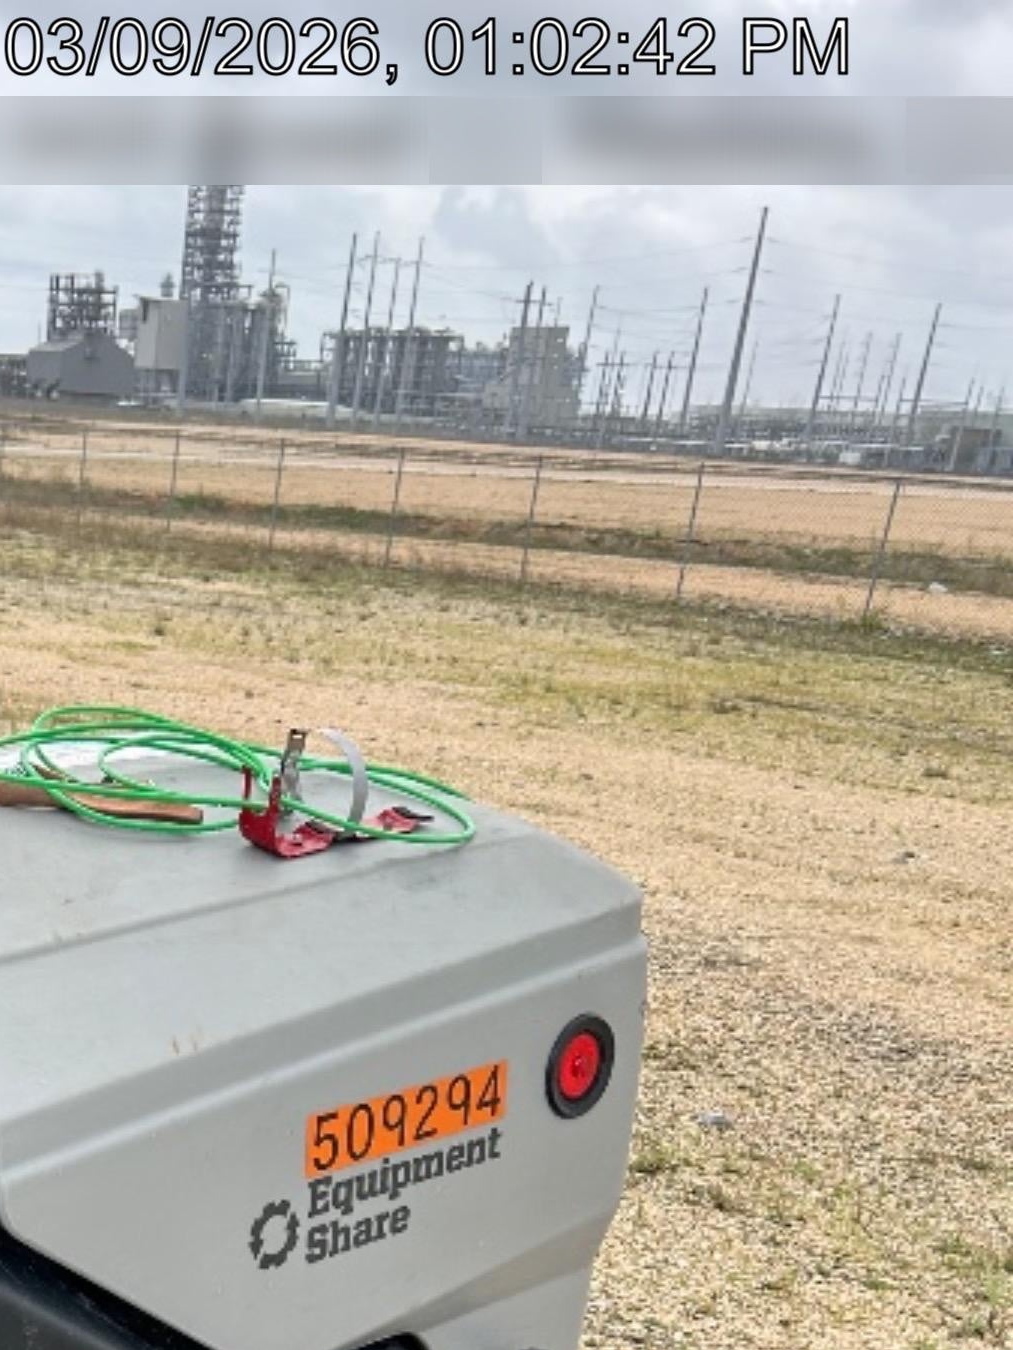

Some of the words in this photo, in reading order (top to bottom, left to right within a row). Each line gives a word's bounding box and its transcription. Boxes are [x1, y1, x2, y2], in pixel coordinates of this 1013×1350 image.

[312, 1064, 502, 1171] 509294
[307, 1126, 503, 1219] Equipment
[304, 1204, 411, 1265] Share
